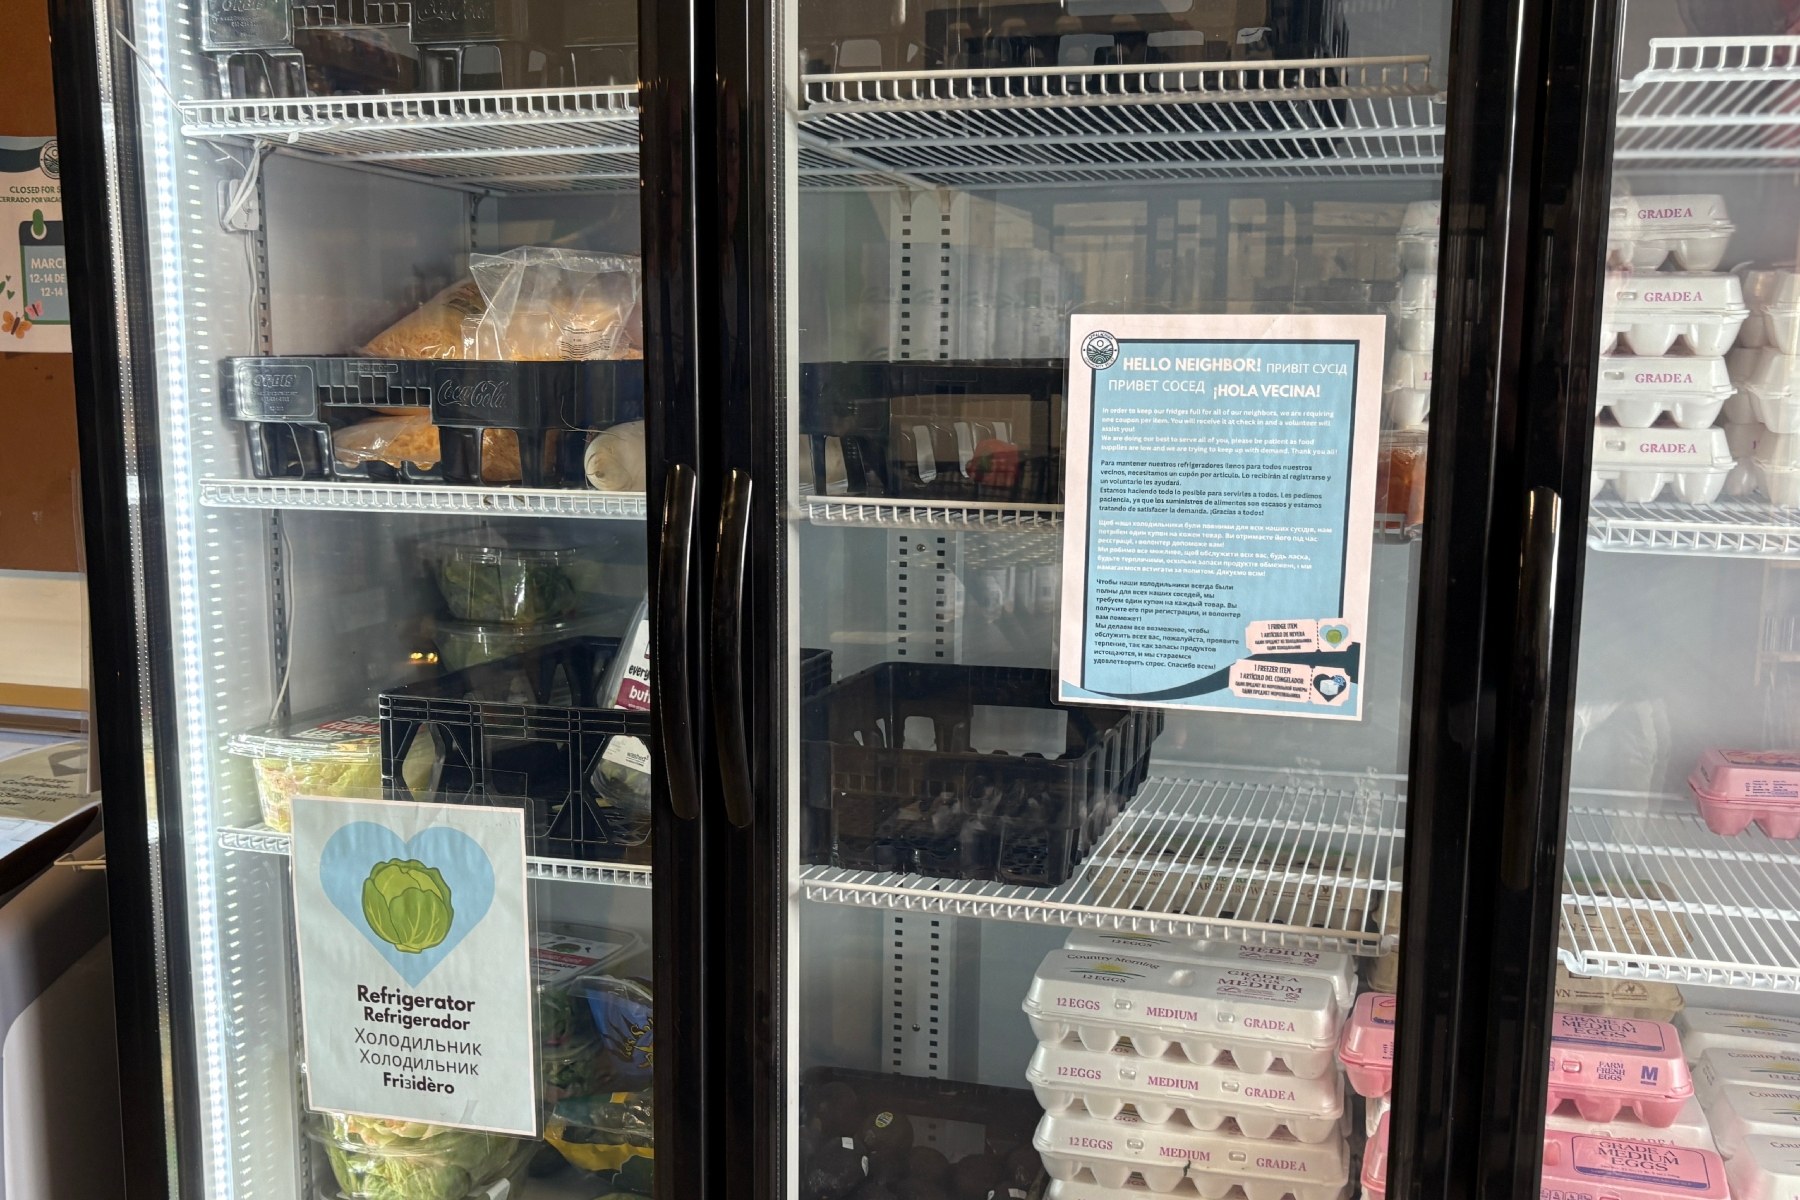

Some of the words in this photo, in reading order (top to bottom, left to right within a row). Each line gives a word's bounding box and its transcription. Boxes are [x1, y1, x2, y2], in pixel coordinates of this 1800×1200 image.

[1638, 208, 1681, 219] GRADE
[1682, 208, 1693, 218] A
[30, 274, 53, 283] 12-14
[40, 288, 63, 296] 12-14
[1644, 292, 1691, 302] GRADE
[1693, 292, 1702, 302] A
[1123, 358, 1171, 371] HELLO
[1175, 358, 1261, 372] NEIGHBOR!
[1266, 363, 1309, 374] ПРИВІТ
[1312, 364, 1347, 375] СУСІД
[1635, 373, 1682, 384] GRADE
[1683, 373, 1693, 383] A
[1108, 380, 1159, 391] ПРИВЕТ
[1162, 380, 1205, 394] СОСЕД
[1213, 384, 1258, 400] ¡HOLA
[1261, 385, 1320, 397] VECINA!
[1136, 407, 1153, 416] keep
[1166, 408, 1189, 417] fridges
[1243, 409, 1278, 419] neighbors,
[1303, 410, 1335, 420] requiring
[1121, 425, 1136, 434] you!
[1640, 443, 1686, 454] GRADE
[1687, 443, 1697, 453] A
[1116, 459, 1147, 467] mantener
[1148, 460, 1177, 468] nuestros
[1177, 460, 1224, 471] refrigeradores
[1283, 464, 1313, 472] nuestros
[1110, 477, 1143, 485] voluntario
[1154, 478, 1182, 488] ayudará.
[1099, 504, 1127, 512] tratando
[1137, 505, 1168, 513] satisfacer
[1240, 945, 1320, 959] MEDIUM
[1116, 956, 1160, 970] Morning
[1095, 975, 1126, 983] EGGS
[1228, 970, 1285, 980] GRADE
[1218, 978, 1302, 994] MEDIUM
[357, 984, 476, 1013] Refrigerator
[1056, 996, 1067, 1008] 12
[1069, 998, 1100, 1011] EGGS
[364, 1007, 470, 1031] Refrigerador
[1146, 1007, 1198, 1022] MEDIUM
[1562, 1015, 1618, 1024] GRADE
[1244, 1018, 1284, 1031] GRADE
[1285, 1022, 1296, 1032] A
[1562, 1020, 1637, 1033] MEDIUM
[1574, 1028, 1626, 1038] EGGS
[355, 1028, 482, 1056] Холодильник
[360, 1049, 479, 1076] Холодильник
[1058, 1067, 1068, 1077] 12
[1070, 1067, 1101, 1080] EGGS
[1596, 1067, 1625, 1076] FRESH
[1641, 1066, 1658, 1080] M
[1148, 1075, 1199, 1090] MEDIUM
[1244, 1087, 1284, 1100] GRADE
[1285, 1091, 1296, 1101] A
[1068, 1136, 1080, 1146] 12
[1081, 1136, 1113, 1150] EGGS
[1600, 1142, 1658, 1154] GRADE
[1159, 1146, 1210, 1161] MEDIUM
[1598, 1148, 1679, 1165] MEDIUM
[1256, 1158, 1296, 1171] GRADE
[1297, 1161, 1306, 1171] A
[1611, 1157, 1668, 1171] EGGS
